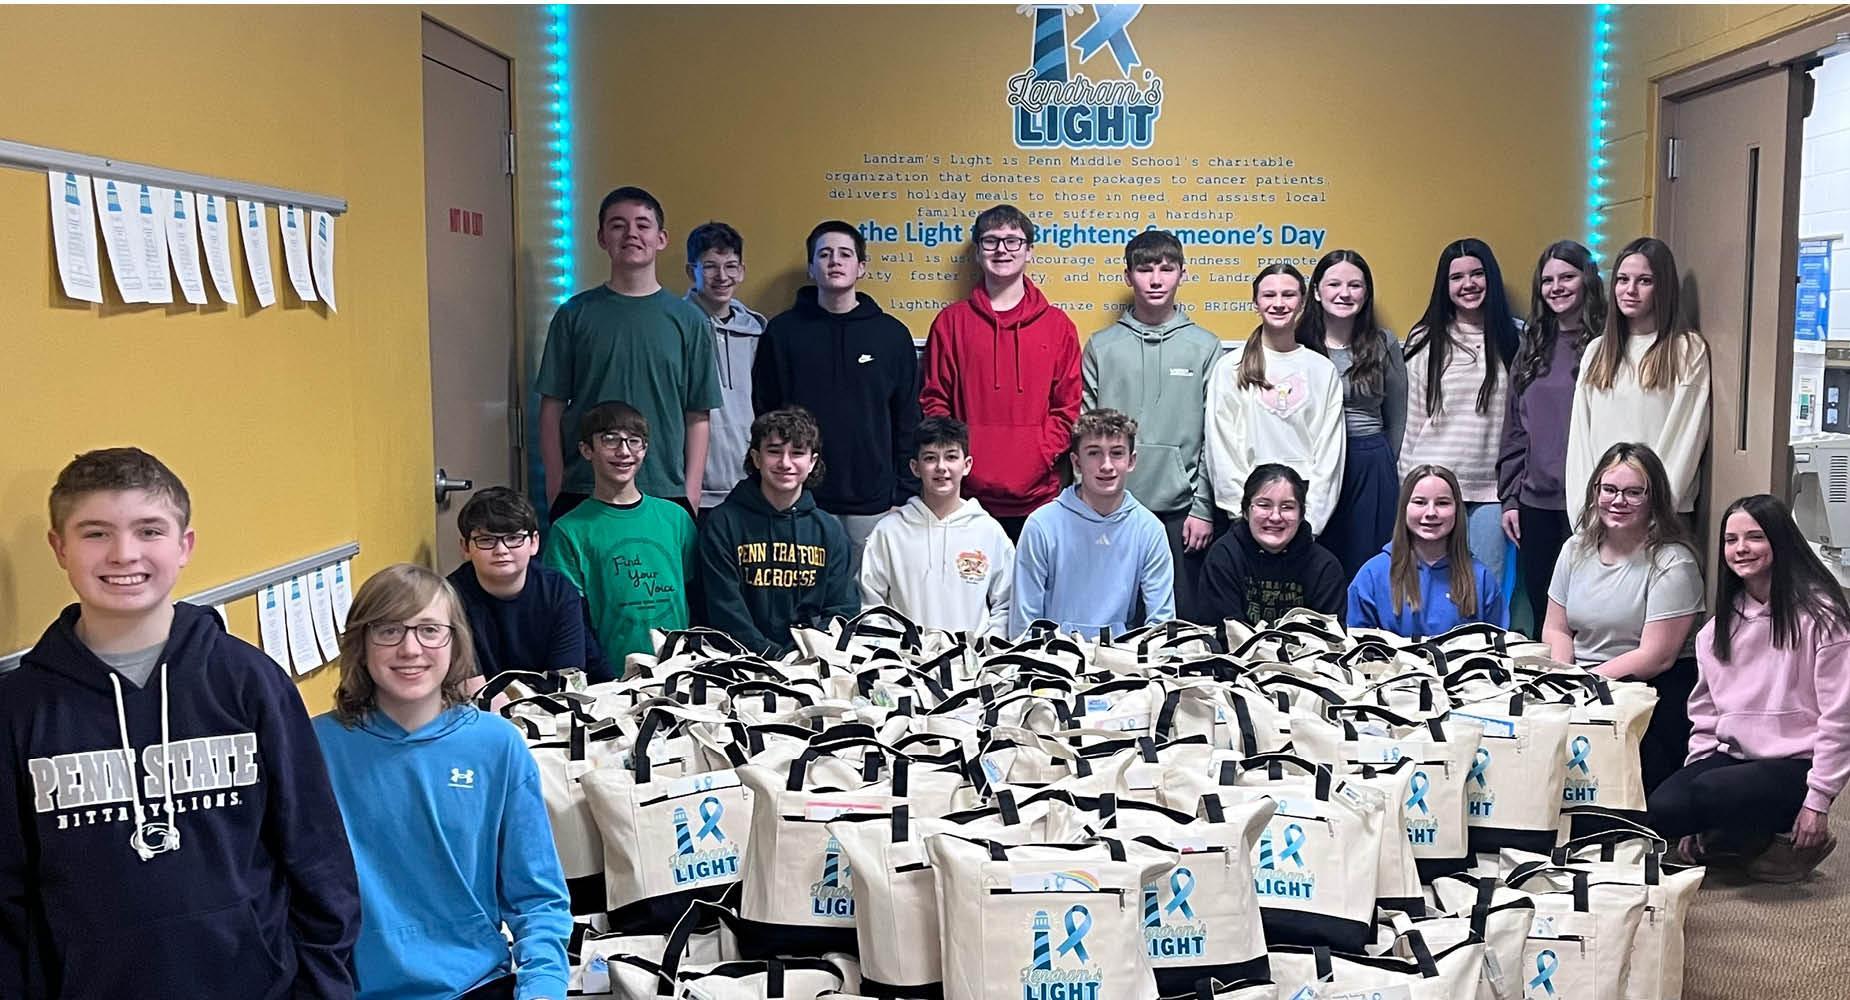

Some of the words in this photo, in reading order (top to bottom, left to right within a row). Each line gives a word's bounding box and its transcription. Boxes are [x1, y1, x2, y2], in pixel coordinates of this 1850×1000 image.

[1009, 69, 1162, 112] Landram's
[1019, 105, 1154, 141] LIGHT
[863, 153, 940, 165] Landram's
[950, 154, 993, 168] Light
[1002, 156, 1018, 166] is
[1028, 155, 1061, 166] Penn
[1070, 156, 1122, 167] Middle
[1130, 156, 1199, 167] School's
[1207, 157, 1294, 167] charitable
[825, 171, 929, 184] organization
[939, 172, 971, 182] that
[980, 173, 1041, 184] donates
[1050, 176, 1084, 184] care
[1092, 174, 1161, 186] packages
[1171, 175, 1187, 185] to
[1196, 176, 1247, 185] cancer
[828, 189, 897, 199] delivers
[907, 190, 967, 202] holiday
[976, 190, 1018, 200] meals
[1028, 192, 1044, 201] to
[1054, 191, 1096, 201] those
[1105, 192, 1122, 201] in
[1182, 192, 1208, 202] and
[1216, 193, 1276, 202] assists
[1286, 192, 1327, 202] local
[1028, 210, 1053, 219] are
[1063, 209, 1140, 222] suffering
[1148, 211, 1156, 220] a
[859, 222, 897, 242] the
[906, 222, 962, 246] Light
[1281, 225, 1326, 249] Day
[881, 252, 914, 263] wall
[925, 254, 941, 263] is
[1030, 256, 1095, 268] ncourage
[911, 270, 959, 281] foster
[1064, 272, 1089, 282] and
[738, 542, 767, 566] PENN
[612, 553, 643, 576] Find
[628, 569, 658, 588] Your
[745, 567, 817, 587] LACROSSE
[643, 580, 675, 597] Voice
[28, 748, 137, 813] PENN
[143, 732, 258, 798] STATE
[675, 856, 737, 883] LIGHT
[1254, 879, 1313, 898] LIGHT
[1148, 936, 1204, 956] IGHT
[1026, 981, 1099, 1000] LIGHT
